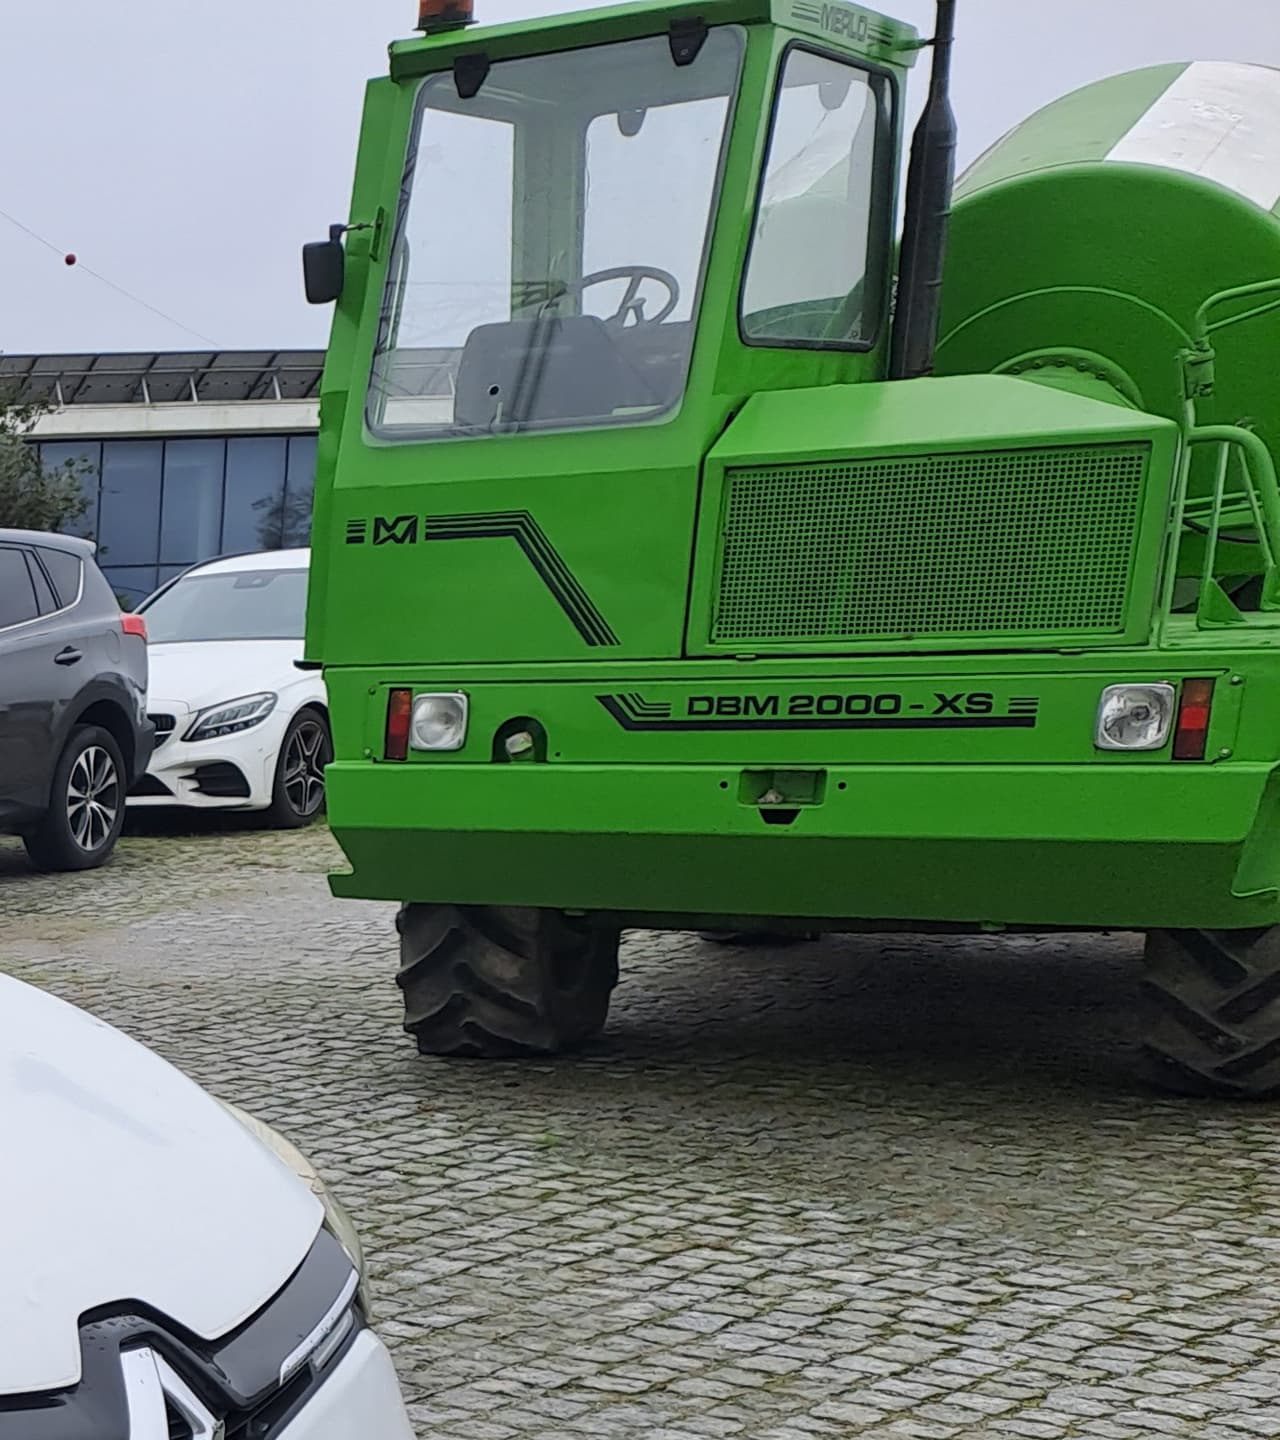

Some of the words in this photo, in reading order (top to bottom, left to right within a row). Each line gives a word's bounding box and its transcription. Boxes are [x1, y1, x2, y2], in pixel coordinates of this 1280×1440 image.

[687, 695, 778, 716] DBM
[788, 694, 901, 715] 2000
[932, 693, 994, 715] XS
